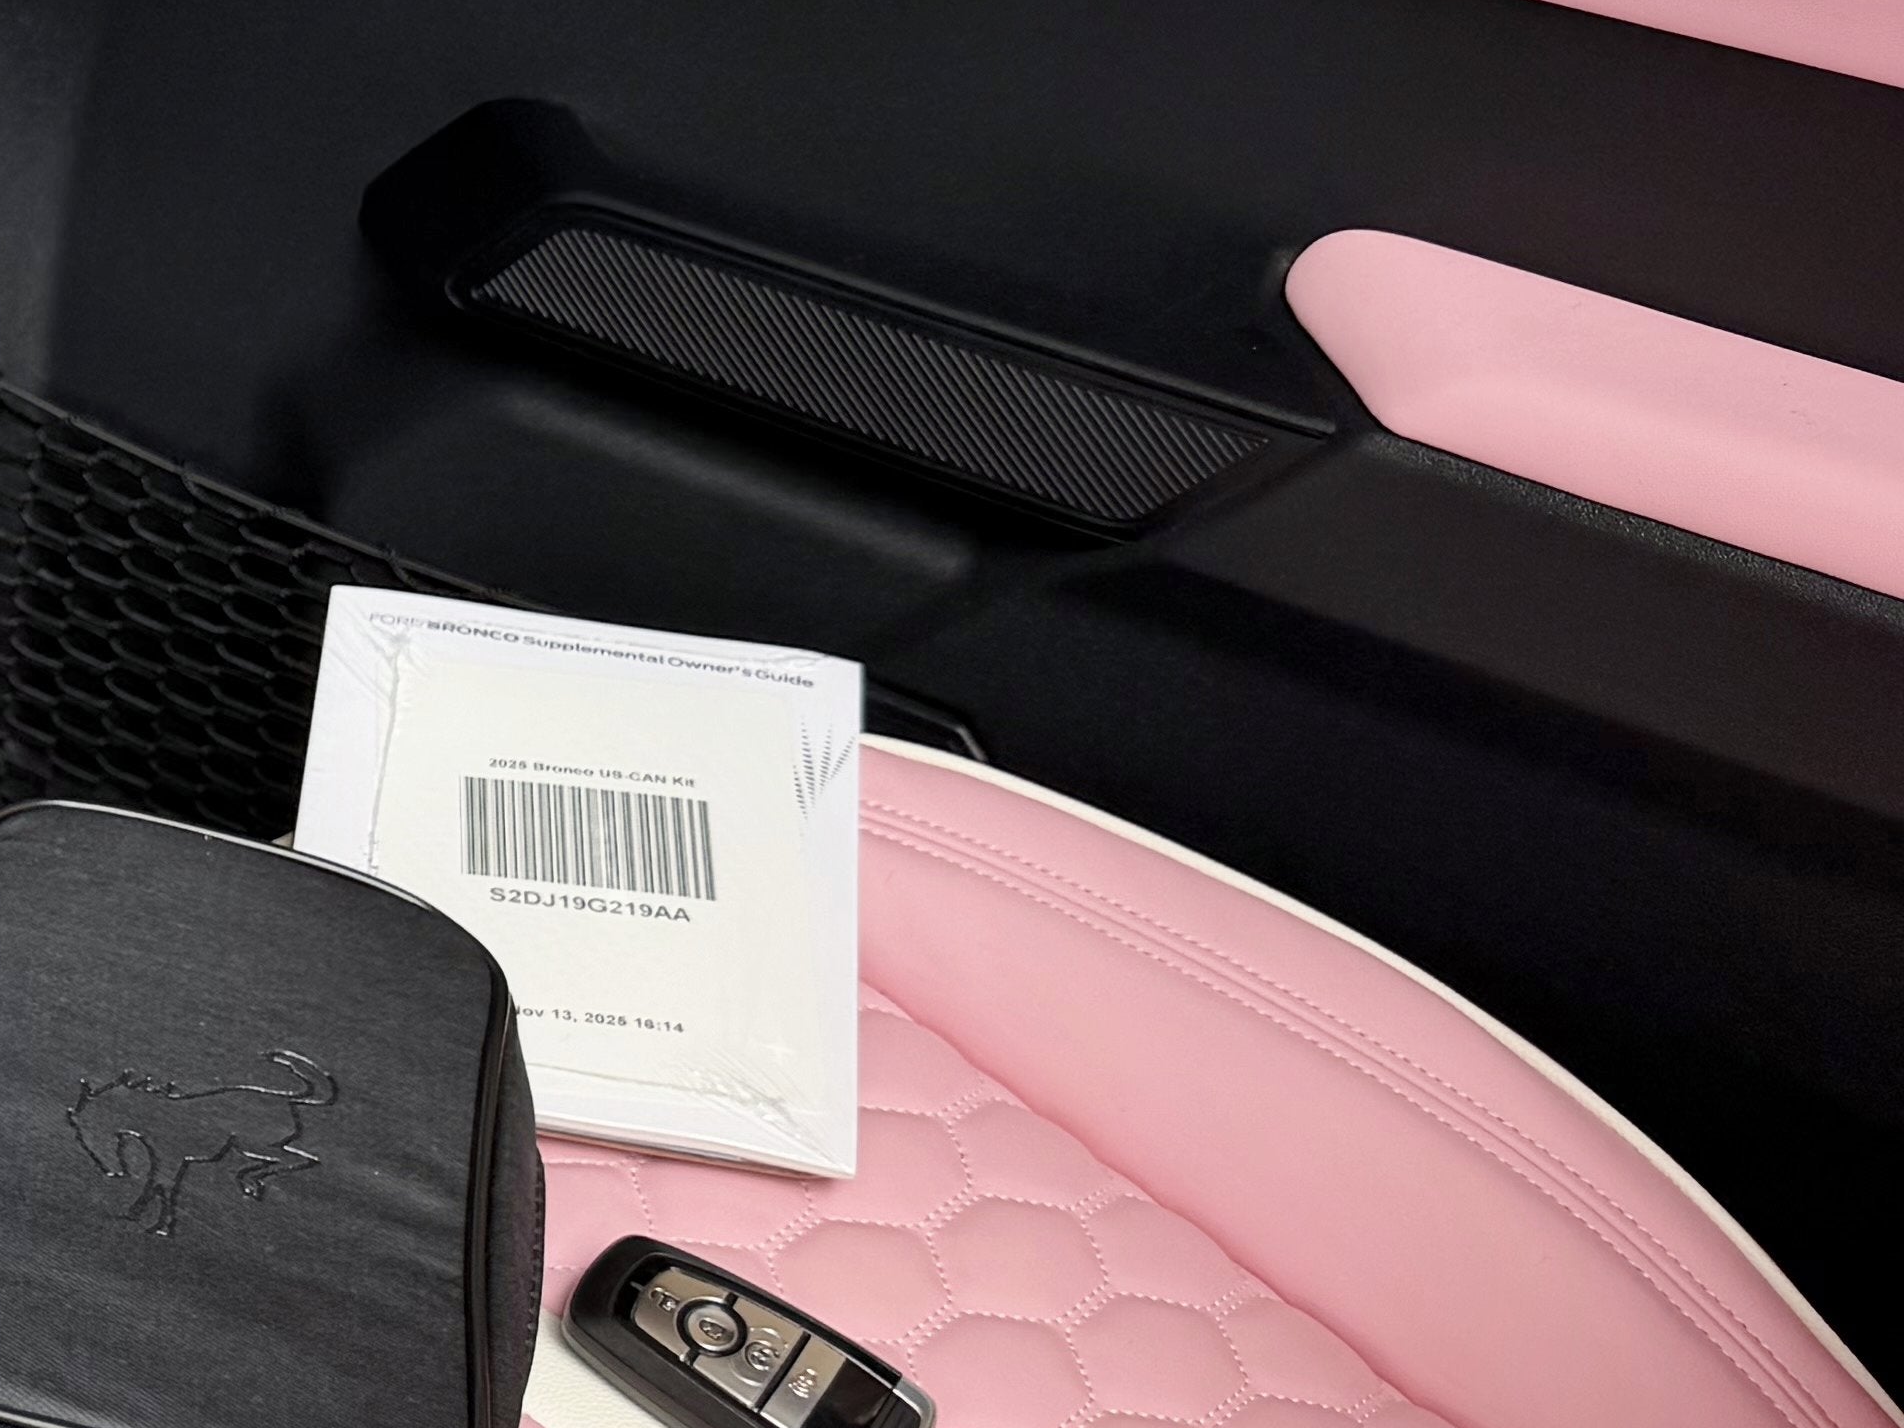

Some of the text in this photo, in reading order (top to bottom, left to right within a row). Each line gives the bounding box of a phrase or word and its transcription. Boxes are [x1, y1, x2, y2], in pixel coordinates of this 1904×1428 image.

[426, 621, 520, 643] BRONCO
[522, 635, 664, 665] Supplemental
[668, 656, 752, 677] Owner's
[755, 669, 814, 688] Guide
[534, 762, 594, 777] Bronco
[672, 776, 695, 788] Kit
[490, 888, 691, 922] S2DJ19G219AA
[552, 1009, 577, 1023] 13,
